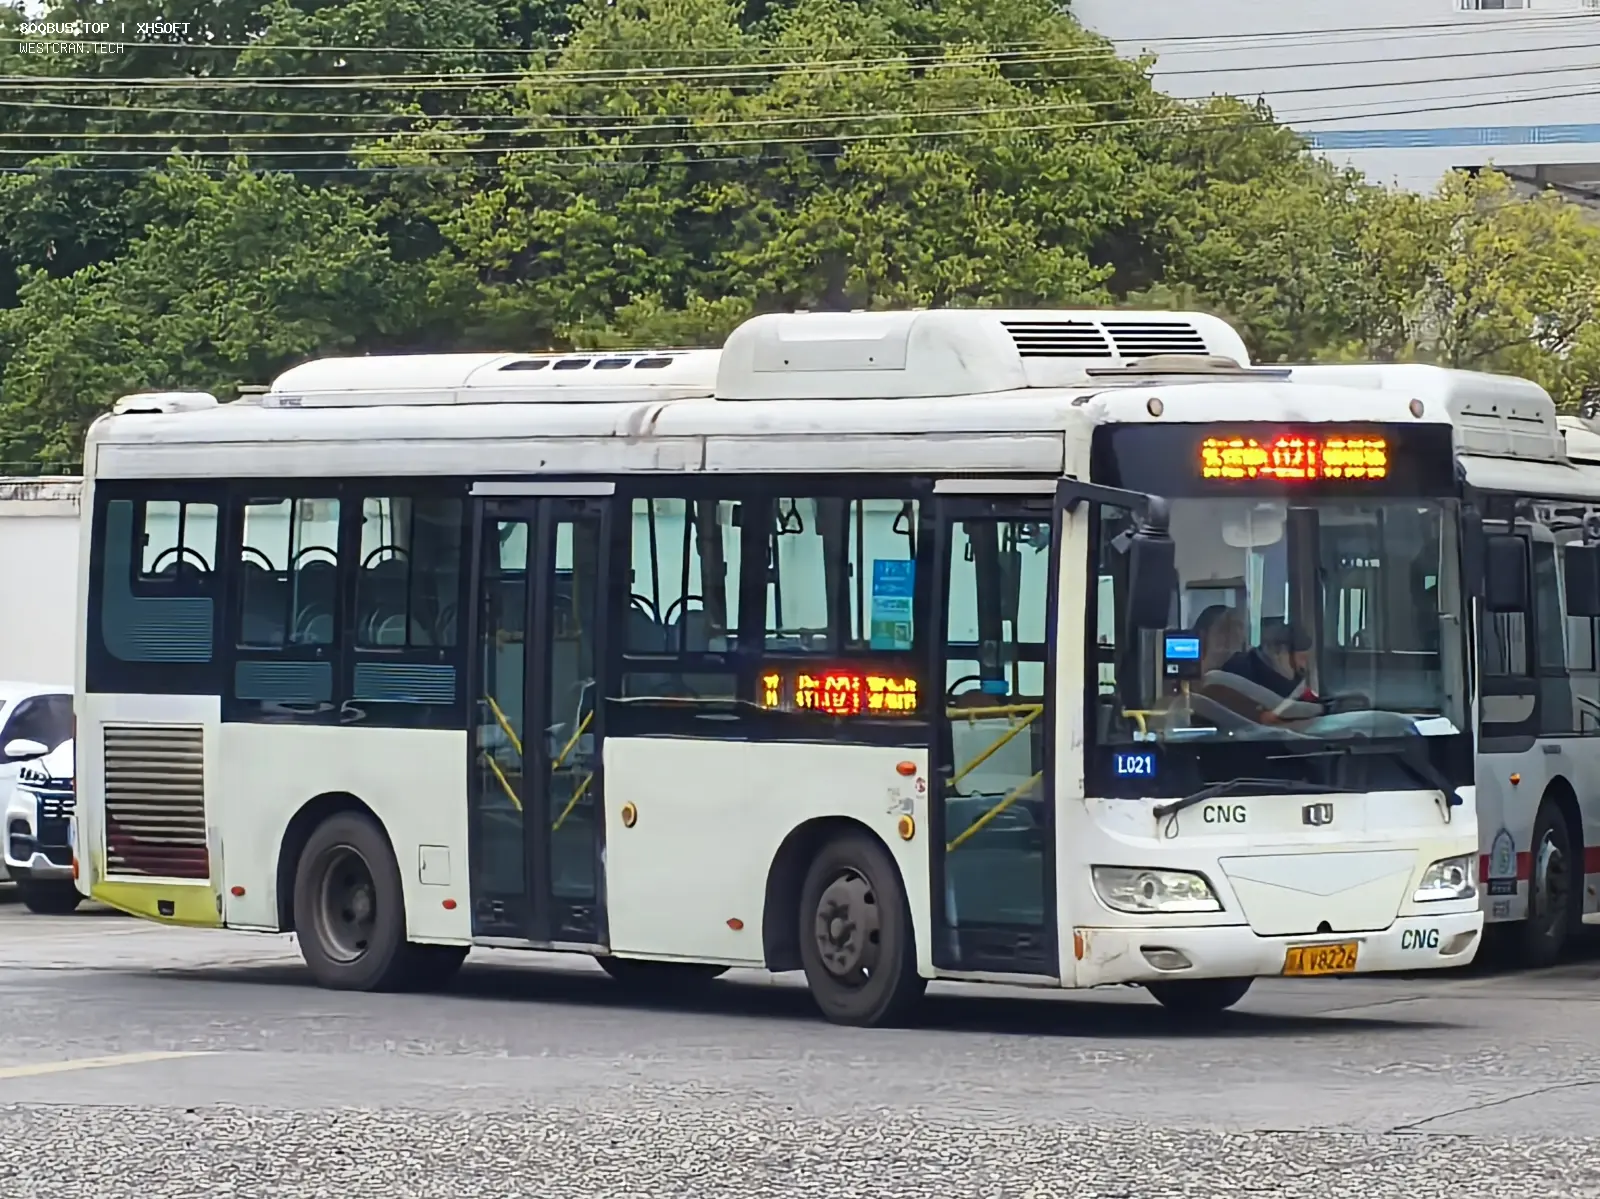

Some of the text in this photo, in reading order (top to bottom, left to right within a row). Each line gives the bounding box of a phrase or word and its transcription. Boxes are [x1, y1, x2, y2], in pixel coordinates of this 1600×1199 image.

[1117, 755, 1152, 774] L021
[1203, 805, 1247, 824] CNG
[1401, 929, 1440, 950] CNG
